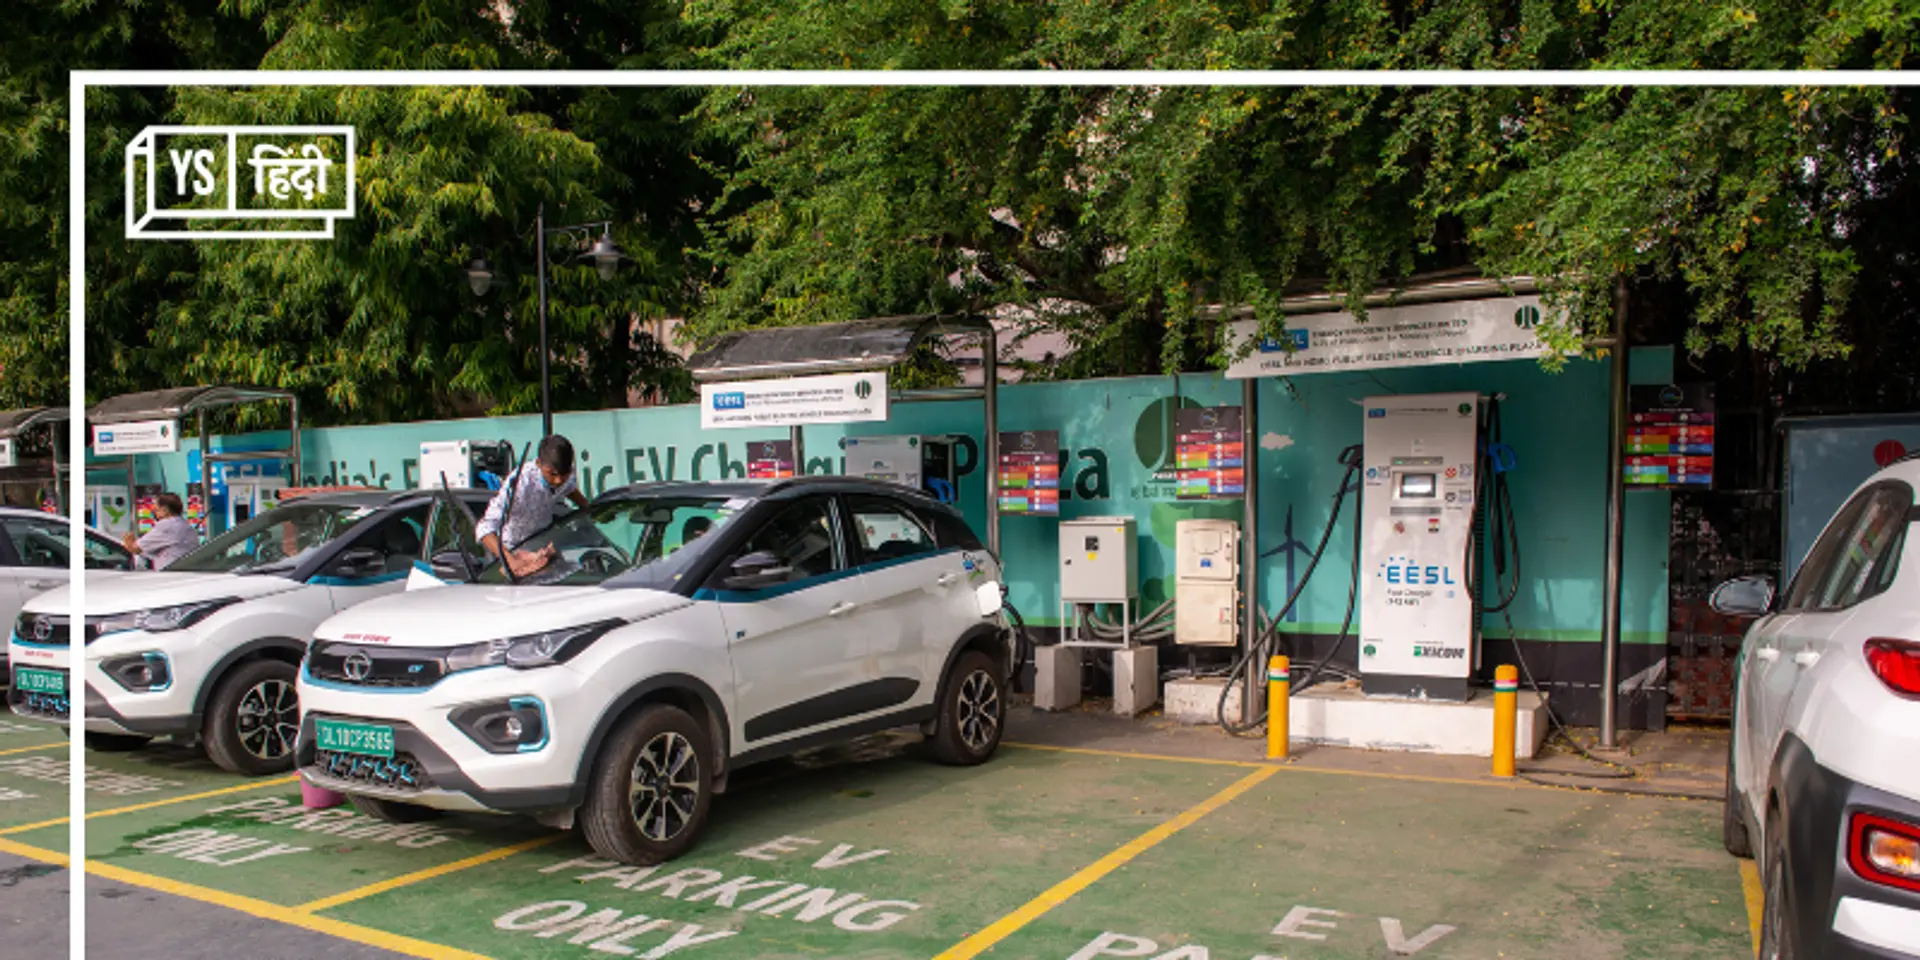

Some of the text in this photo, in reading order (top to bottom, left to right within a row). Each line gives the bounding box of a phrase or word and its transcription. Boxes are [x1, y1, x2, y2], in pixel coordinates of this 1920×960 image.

[1386, 565, 1456, 585] EESL
[133, 828, 310, 867] ONLY
[735, 834, 891, 870] EV
[493, 900, 739, 960] ONLY
[1270, 905, 1457, 956] EV
